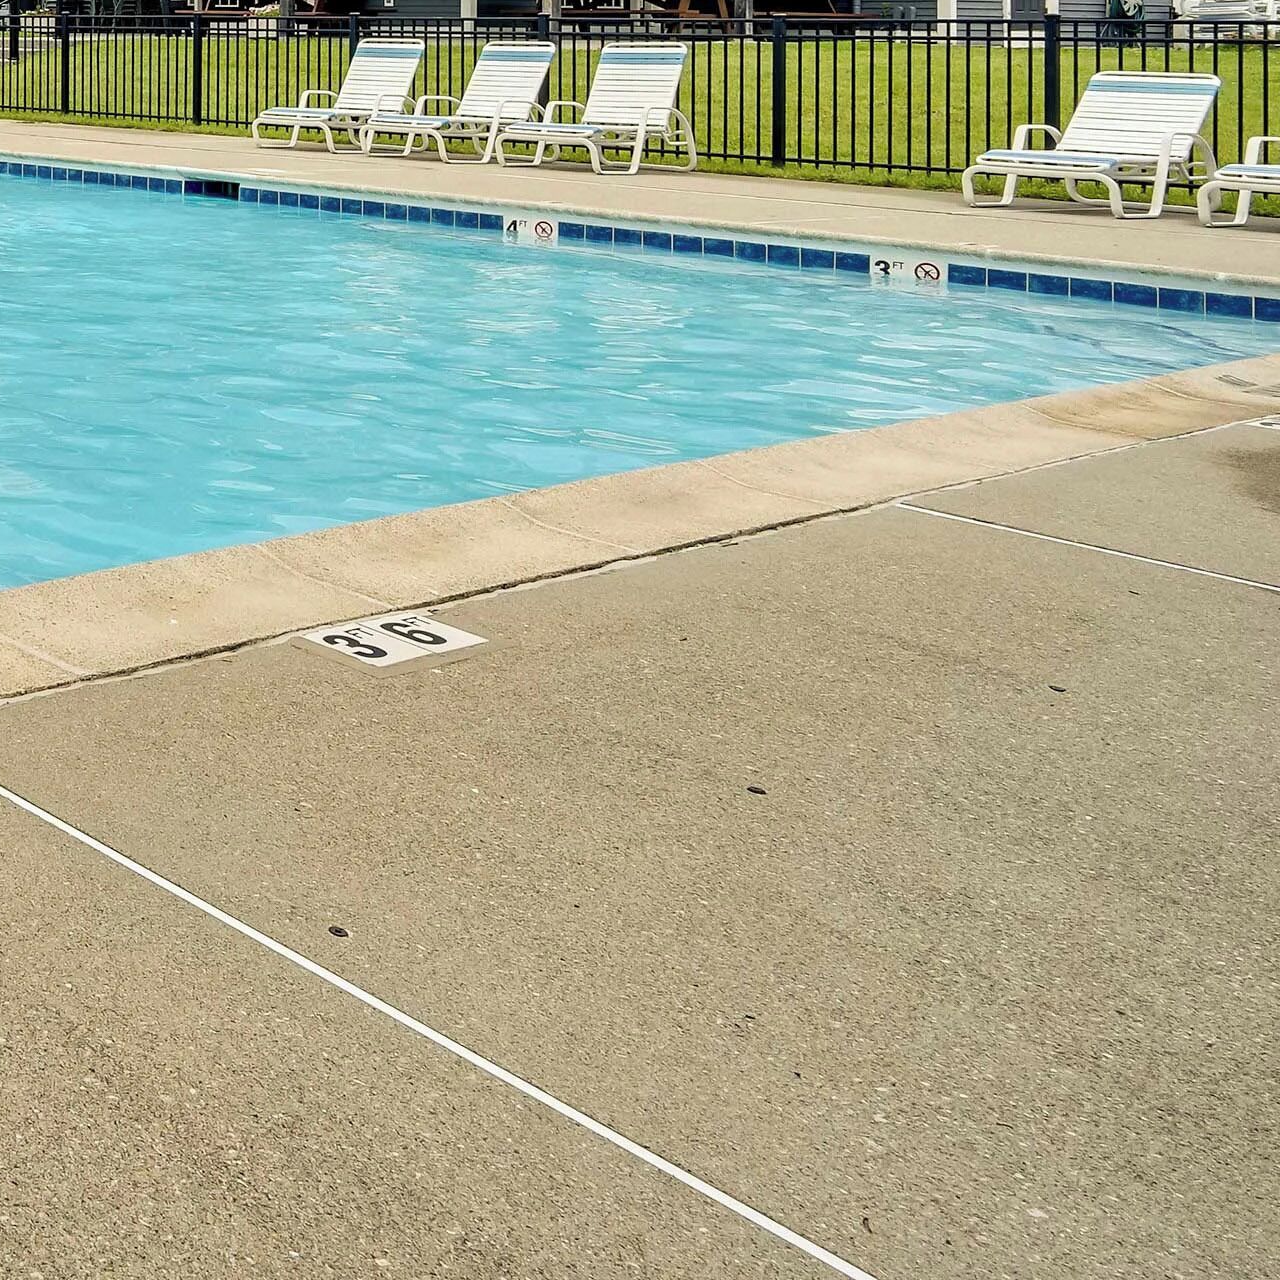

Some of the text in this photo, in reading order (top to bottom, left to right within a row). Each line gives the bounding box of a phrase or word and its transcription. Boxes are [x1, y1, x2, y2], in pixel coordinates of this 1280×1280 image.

[893, 261, 904, 269] FT
[322, 634, 388, 658] 3
[379, 622, 448, 645] 6
